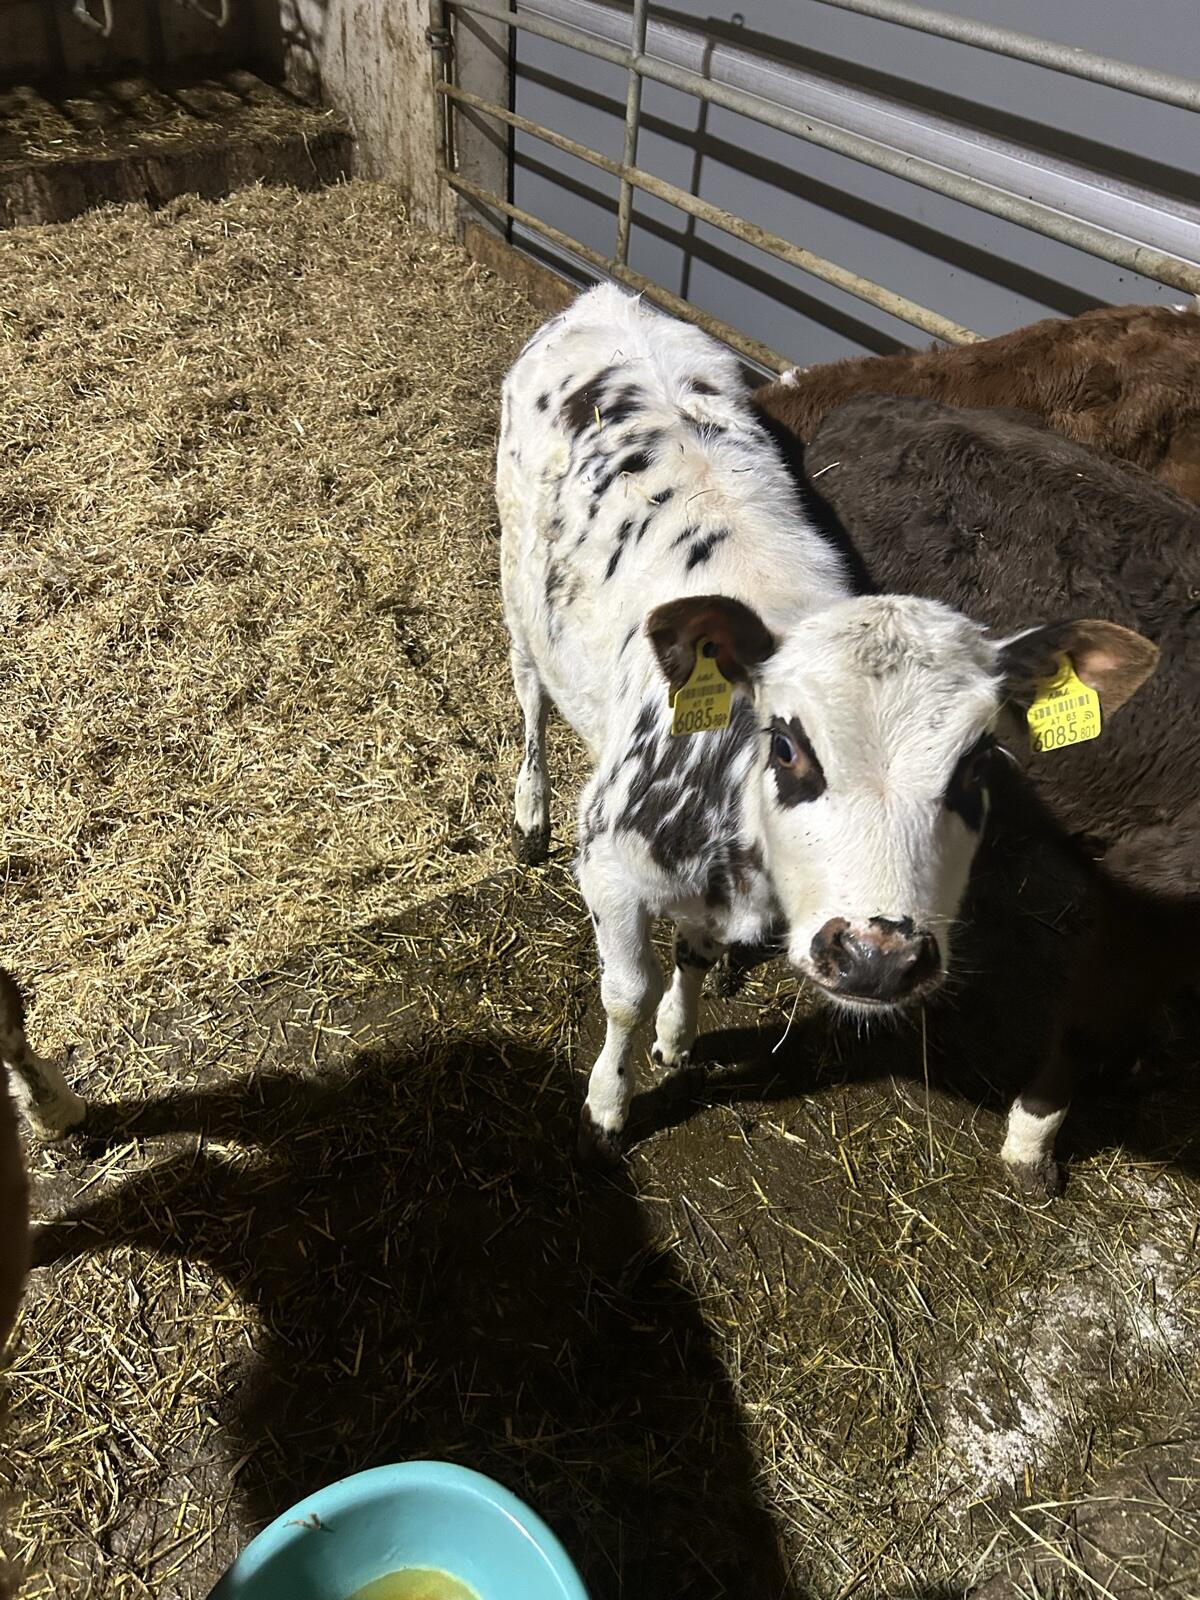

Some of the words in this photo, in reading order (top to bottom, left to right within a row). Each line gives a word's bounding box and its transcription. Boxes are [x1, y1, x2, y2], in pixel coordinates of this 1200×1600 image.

[676, 707, 713, 733] 6085
[1051, 716, 1061, 726] AT
[1033, 721, 1078, 752] 6085
[1080, 724, 1096, 739] 801
